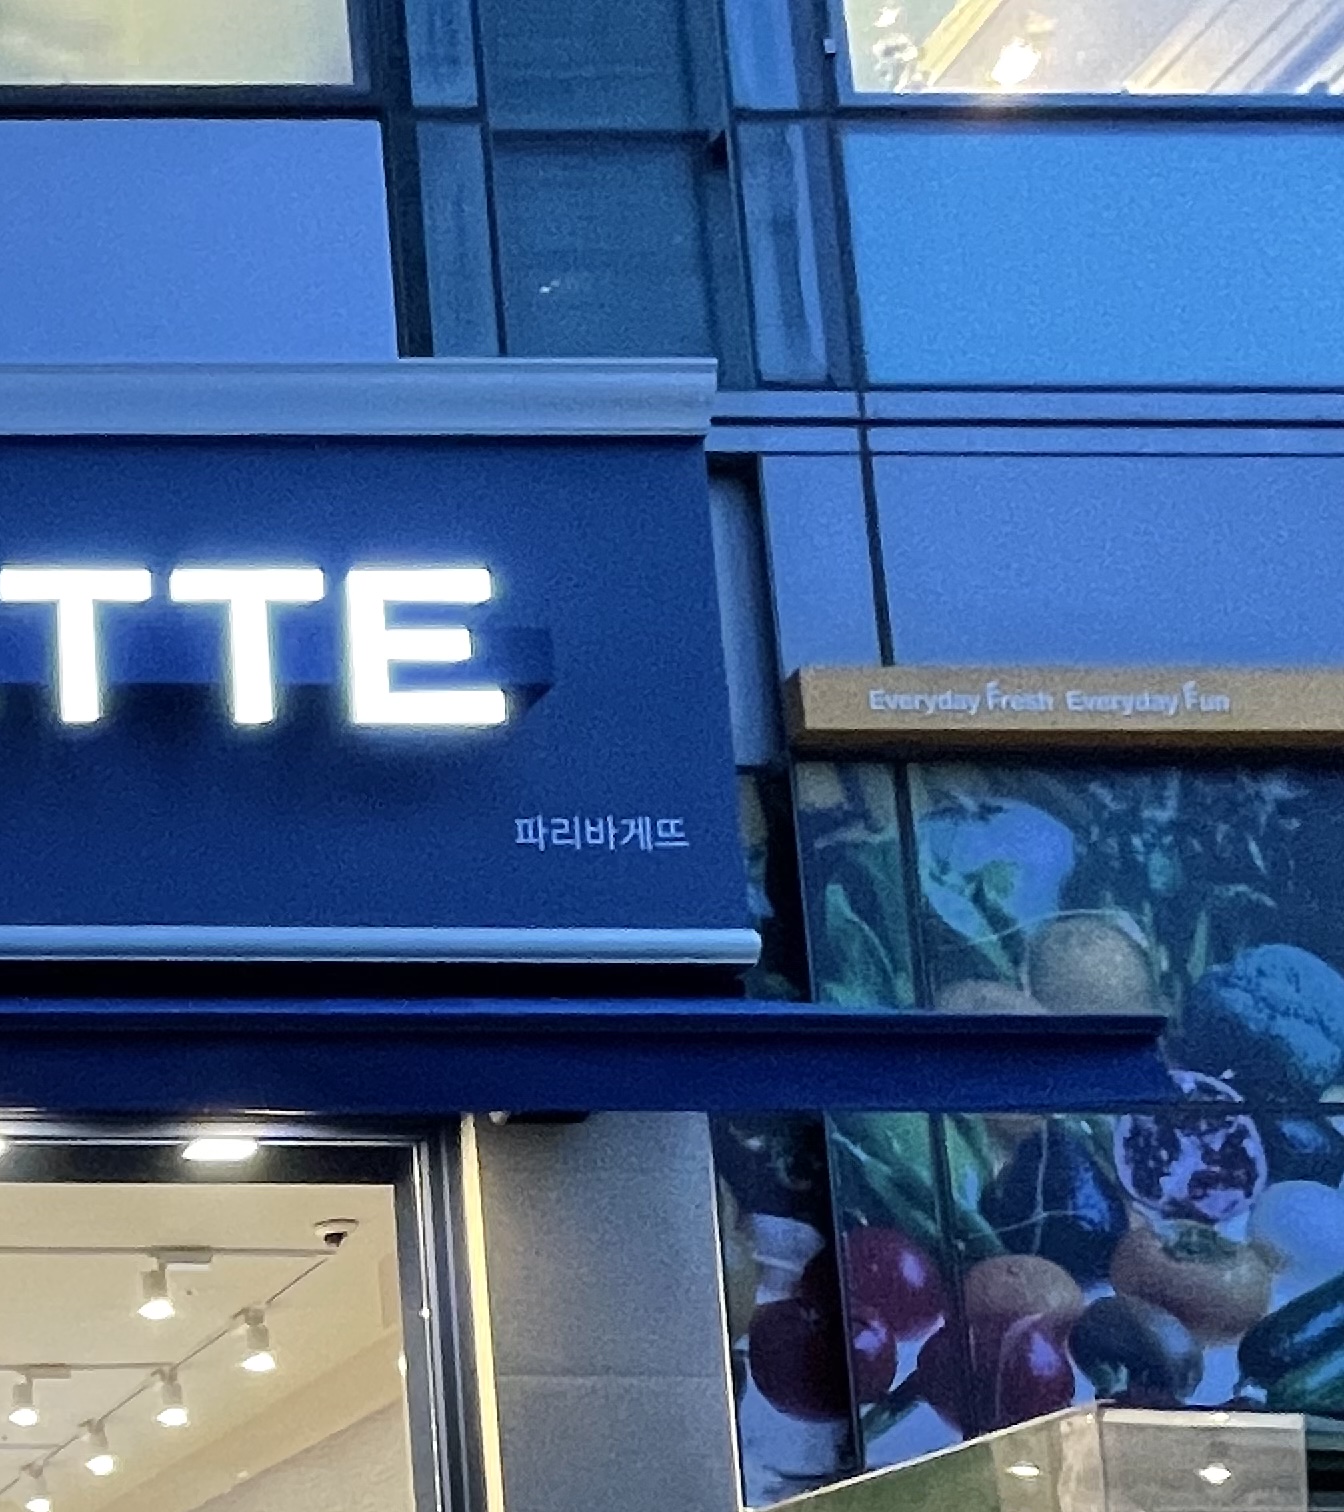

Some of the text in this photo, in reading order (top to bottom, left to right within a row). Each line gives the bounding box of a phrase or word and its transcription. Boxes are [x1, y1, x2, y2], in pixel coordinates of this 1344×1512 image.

[867, 680, 1231, 718] Everyday Fresh Everyday Fun
[514, 814, 690, 852] 파리바게뜨
